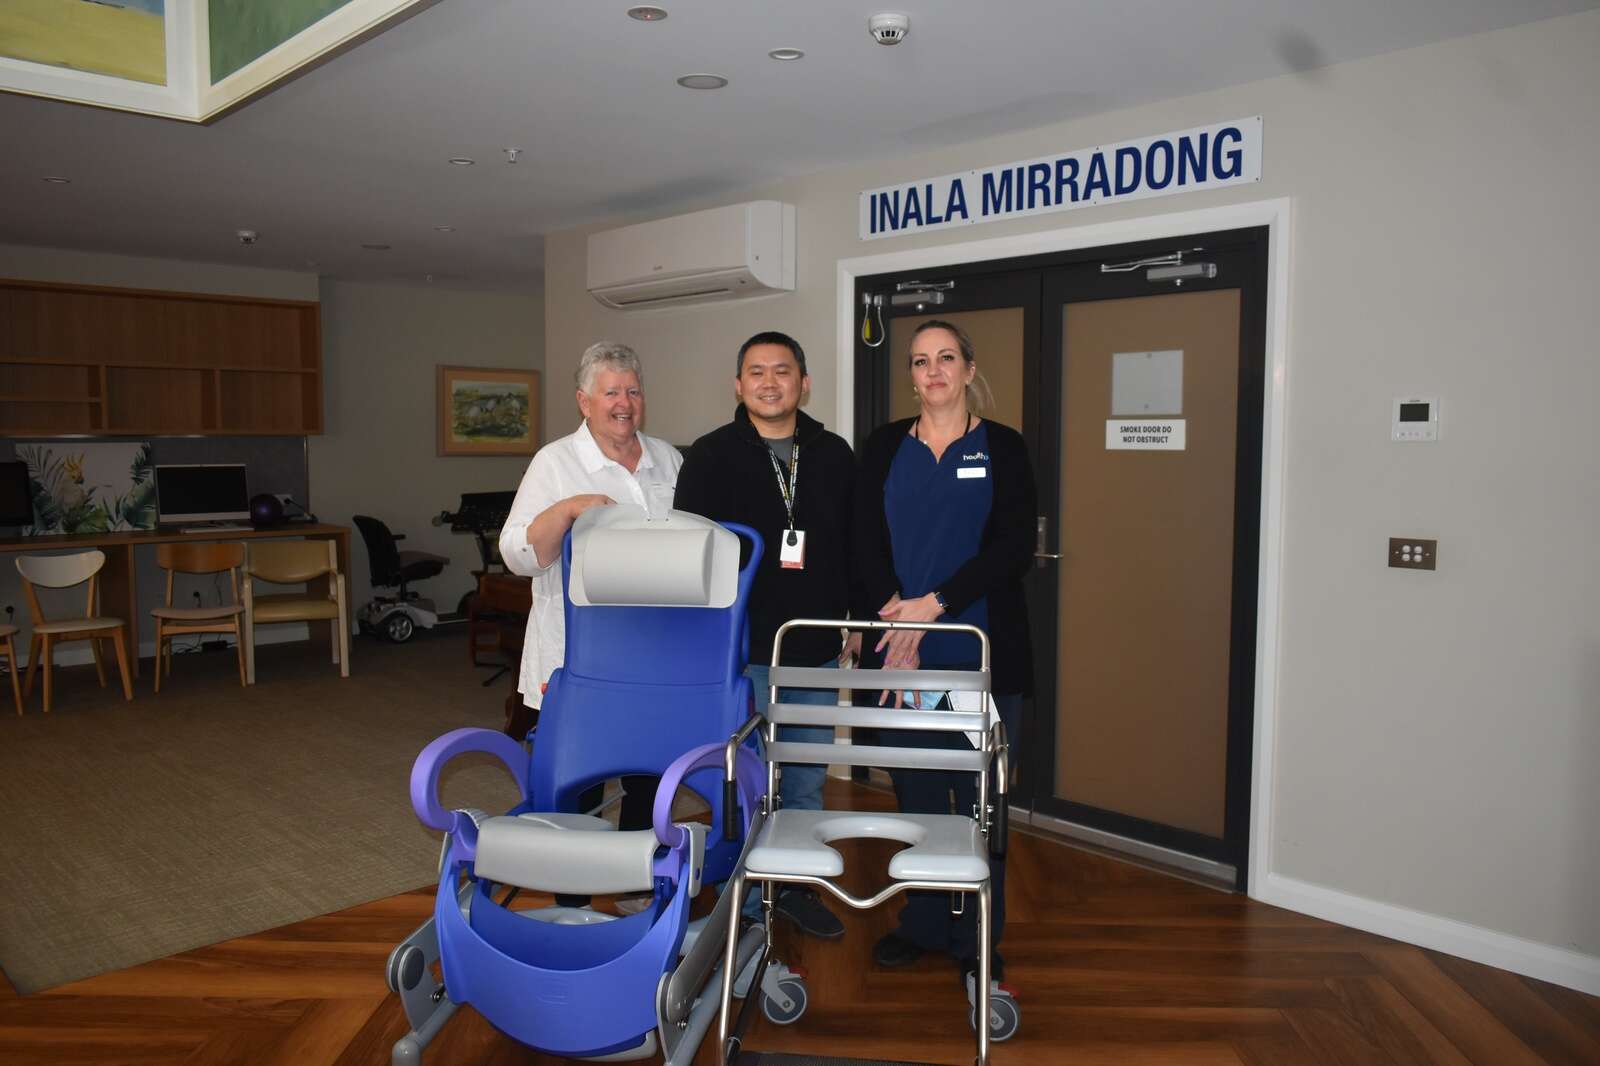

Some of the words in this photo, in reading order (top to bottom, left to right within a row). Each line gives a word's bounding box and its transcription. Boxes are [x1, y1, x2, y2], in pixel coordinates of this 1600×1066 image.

[870, 178, 969, 234] INALA
[981, 127, 1243, 217] MIRRADONG
[1120, 425, 1142, 433] SMOKE
[1143, 425, 1161, 433] DOOR
[1162, 425, 1172, 433] DO
